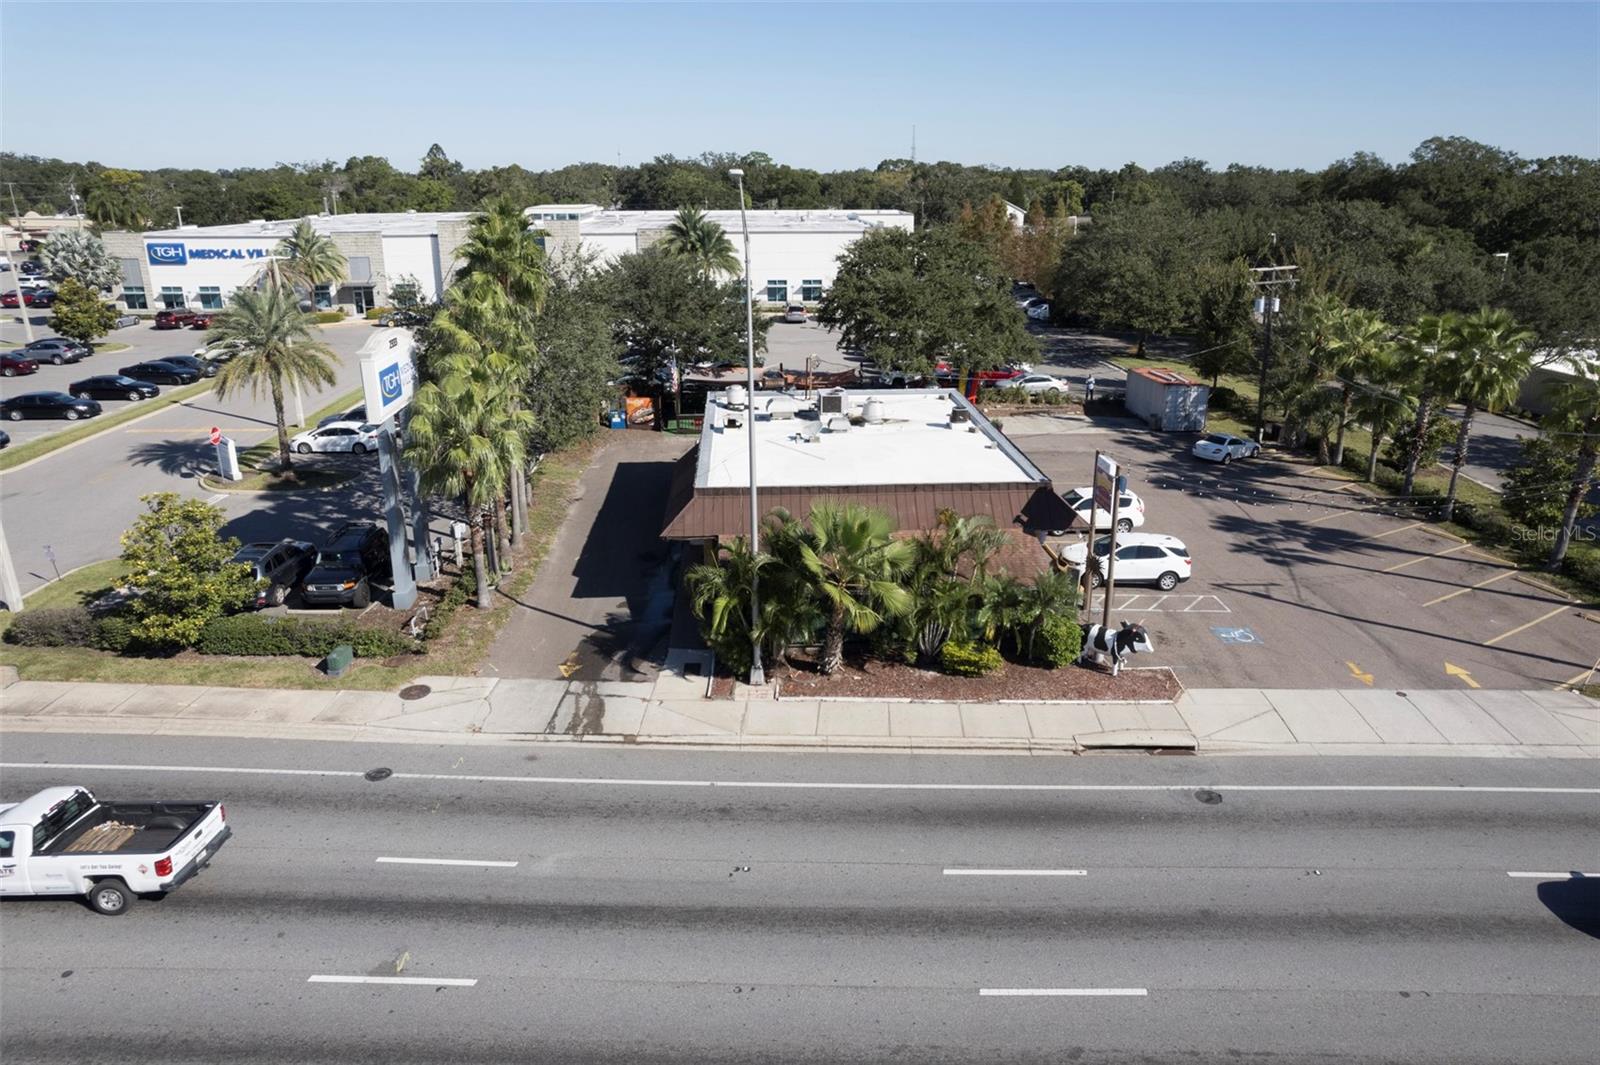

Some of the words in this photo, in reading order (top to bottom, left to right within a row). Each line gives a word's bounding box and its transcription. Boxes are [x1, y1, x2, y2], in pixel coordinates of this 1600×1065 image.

[154, 246, 183, 257] TGH
[188, 248, 246, 259] MEDICAL
[383, 370, 401, 392] TGH
